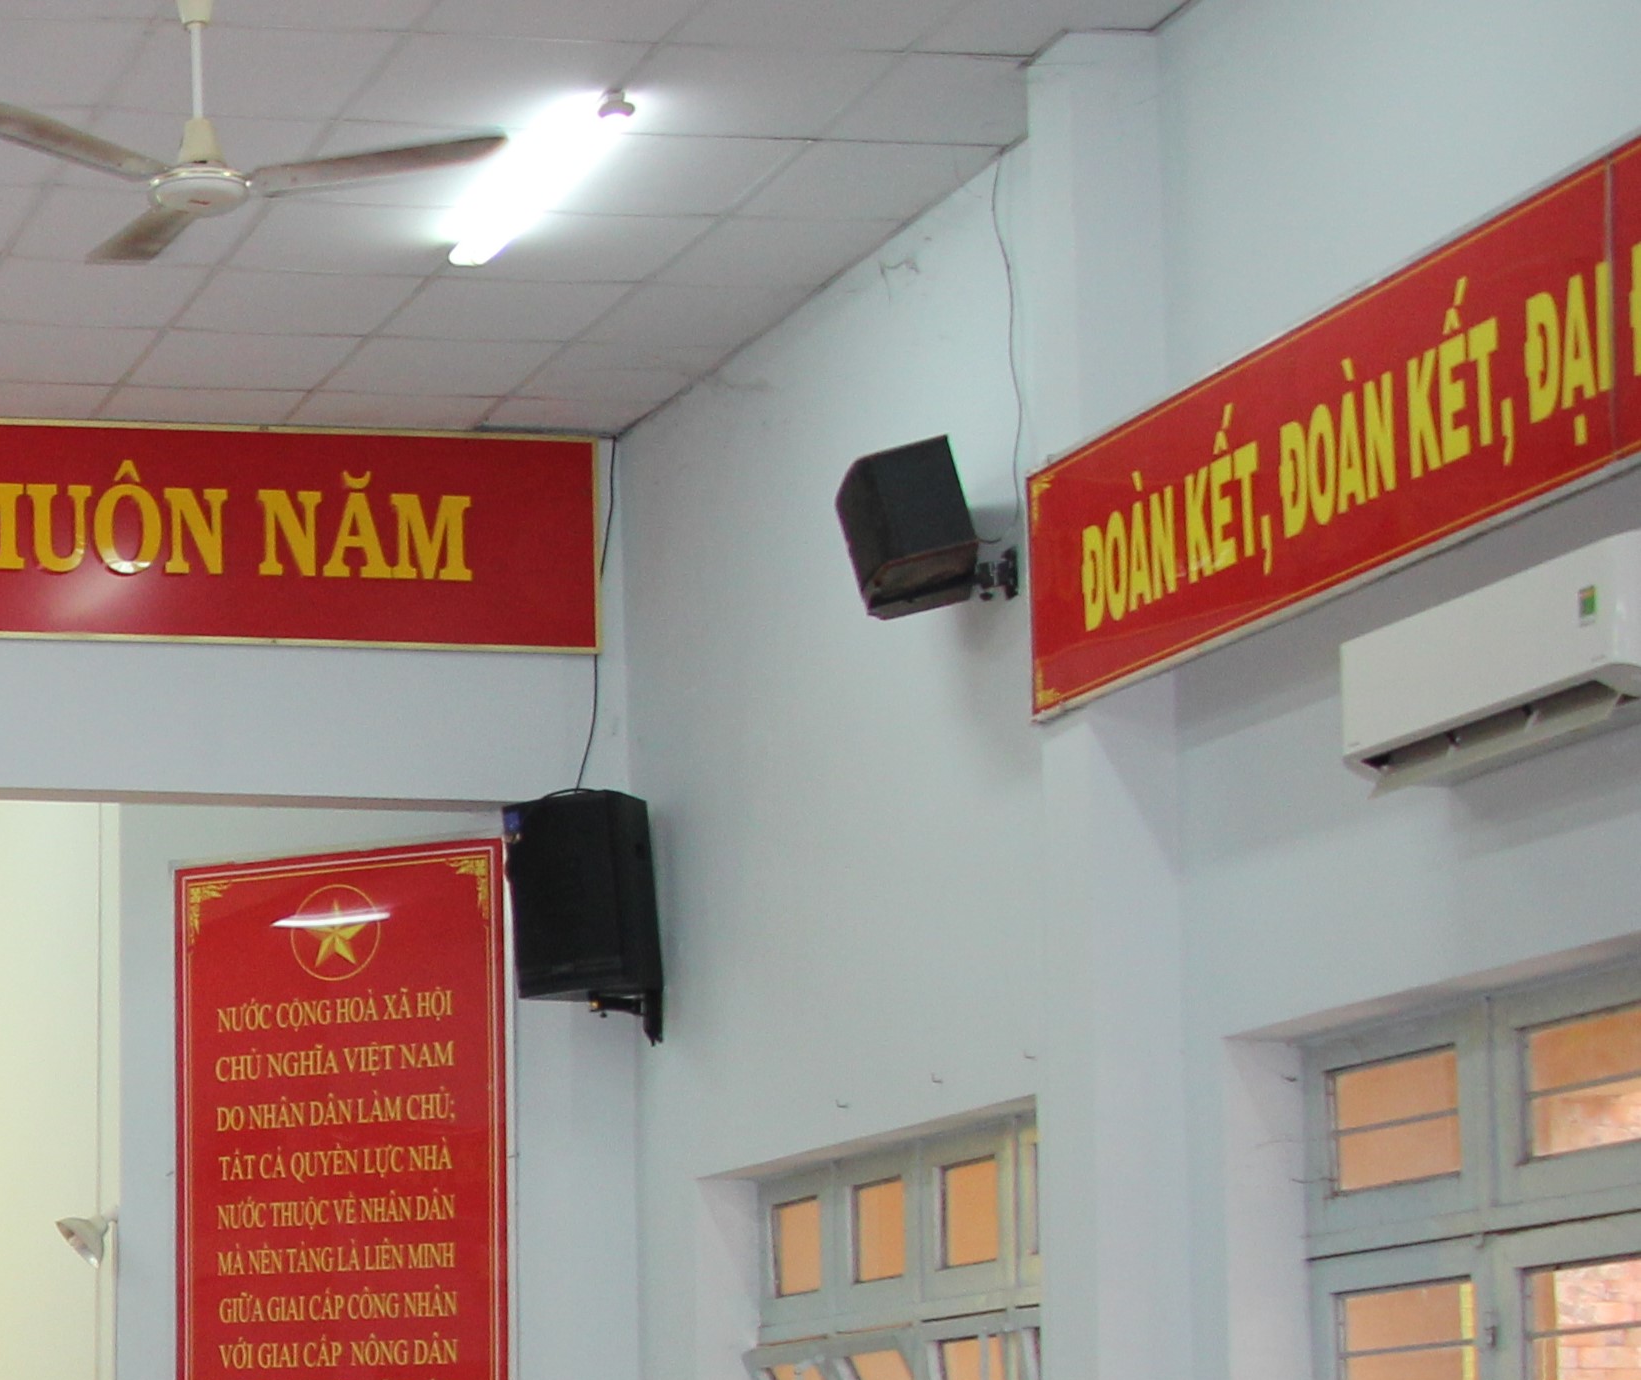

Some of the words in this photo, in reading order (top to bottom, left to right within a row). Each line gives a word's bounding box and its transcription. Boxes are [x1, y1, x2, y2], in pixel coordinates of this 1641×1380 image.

[1081, 471, 1177, 631] ĐOÀN
[1184, 403, 1272, 583] KẾT,
[1279, 357, 1397, 539] ĐOÀN
[1406, 276, 1514, 466] KẾT,
[1523, 261, 1613, 447] ĐẠI
[257, 469, 472, 582] NĂM
[217, 998, 272, 1032] NƯỚC
[276, 999, 332, 1032] CỘNG
[382, 987, 412, 1020] XÃ
[417, 987, 453, 1021] HỘI
[215, 1048, 262, 1082] CHỦ
[267, 1044, 339, 1078] NGHĨA
[342, 1042, 395, 1076] VIỆT
[399, 1041, 454, 1069] NAM
[217, 1106, 245, 1132] DO
[248, 1096, 305, 1130] NHÂN
[310, 1093, 352, 1126] DÂN
[357, 1090, 402, 1123] LÀM
[219, 1149, 256, 1181] TẤT
[290, 1142, 358, 1183] QUYỀN
[364, 1144, 404, 1178] LỰC
[409, 1136, 452, 1171] NHÀ
[217, 1196, 267, 1230] NƯỚC
[270, 1196, 330, 1230] THUỘC
[332, 1191, 356, 1224] VỀ
[360, 1189, 412, 1223] NHÂN
[416, 1187, 455, 1221] DÂN
[217, 1243, 245, 1276] MÀ
[248, 1242, 283, 1275] NỀN
[286, 1241, 335, 1273] TẢNG
[337, 1238, 360, 1272] LÀ
[364, 1237, 404, 1270] LIÊN
[407, 1242, 455, 1269] MINH
[219, 1292, 265, 1323] GIỮA
[267, 1296, 305, 1322] GIAI
[309, 1287, 344, 1320] CẤP
[347, 1286, 399, 1319] CÔNG
[403, 1284, 457, 1317] NHÂN
[219, 1336, 252, 1369] VỚI
[258, 1342, 298, 1369] GIAI
[303, 1334, 343, 1367] CẤP
[350, 1333, 408, 1367] NÔNG
[413, 1332, 458, 1365] DÂN
